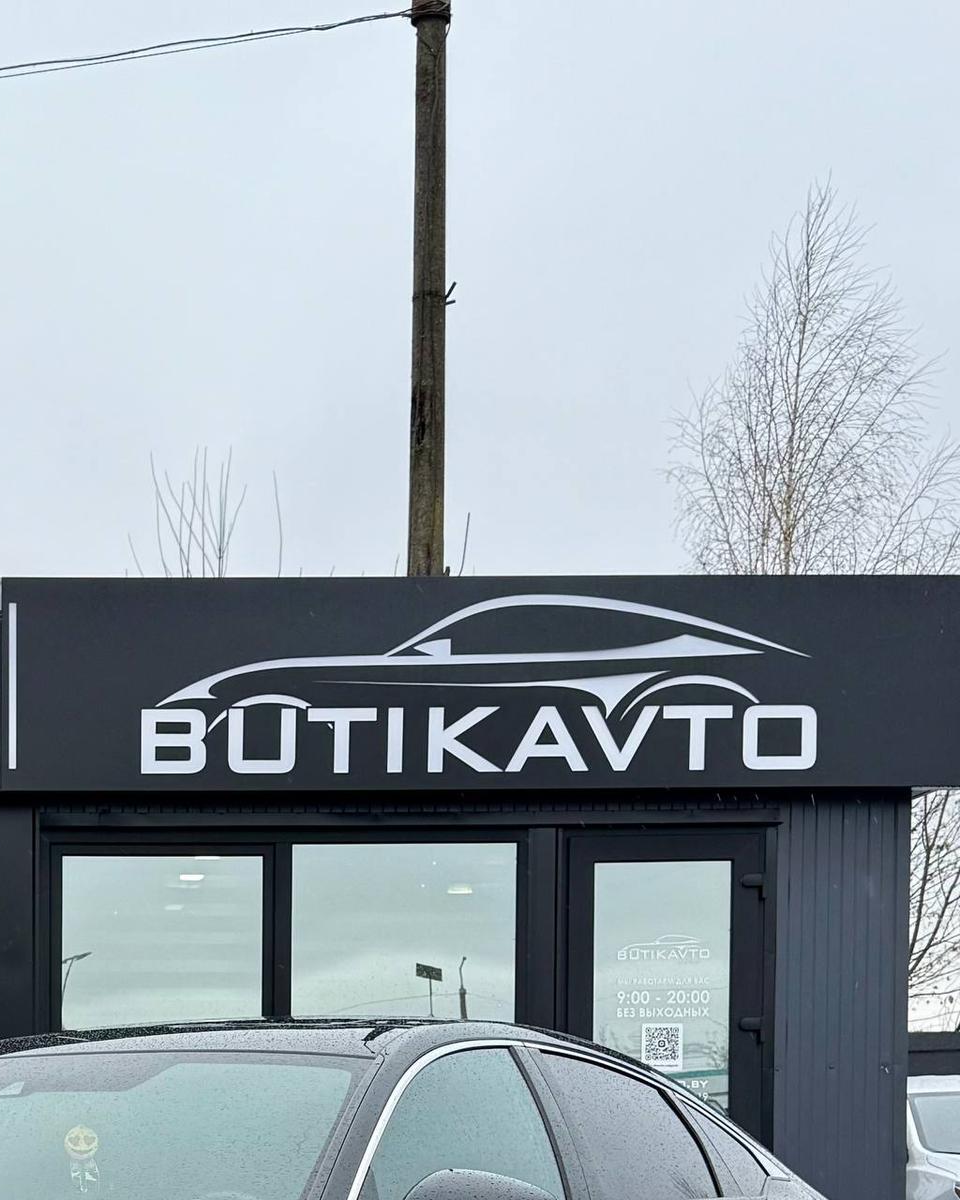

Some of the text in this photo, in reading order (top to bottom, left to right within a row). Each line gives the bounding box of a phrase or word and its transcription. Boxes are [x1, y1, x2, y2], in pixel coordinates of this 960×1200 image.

[140, 705, 818, 775] BUTIKAVTO
[618, 949, 709, 960] BUTIKAVTO
[617, 991, 649, 1004] 9:00
[667, 990, 709, 1003] 20:00
[617, 1008, 709, 1017] БЕЗ ВЫХОДНЫХ
